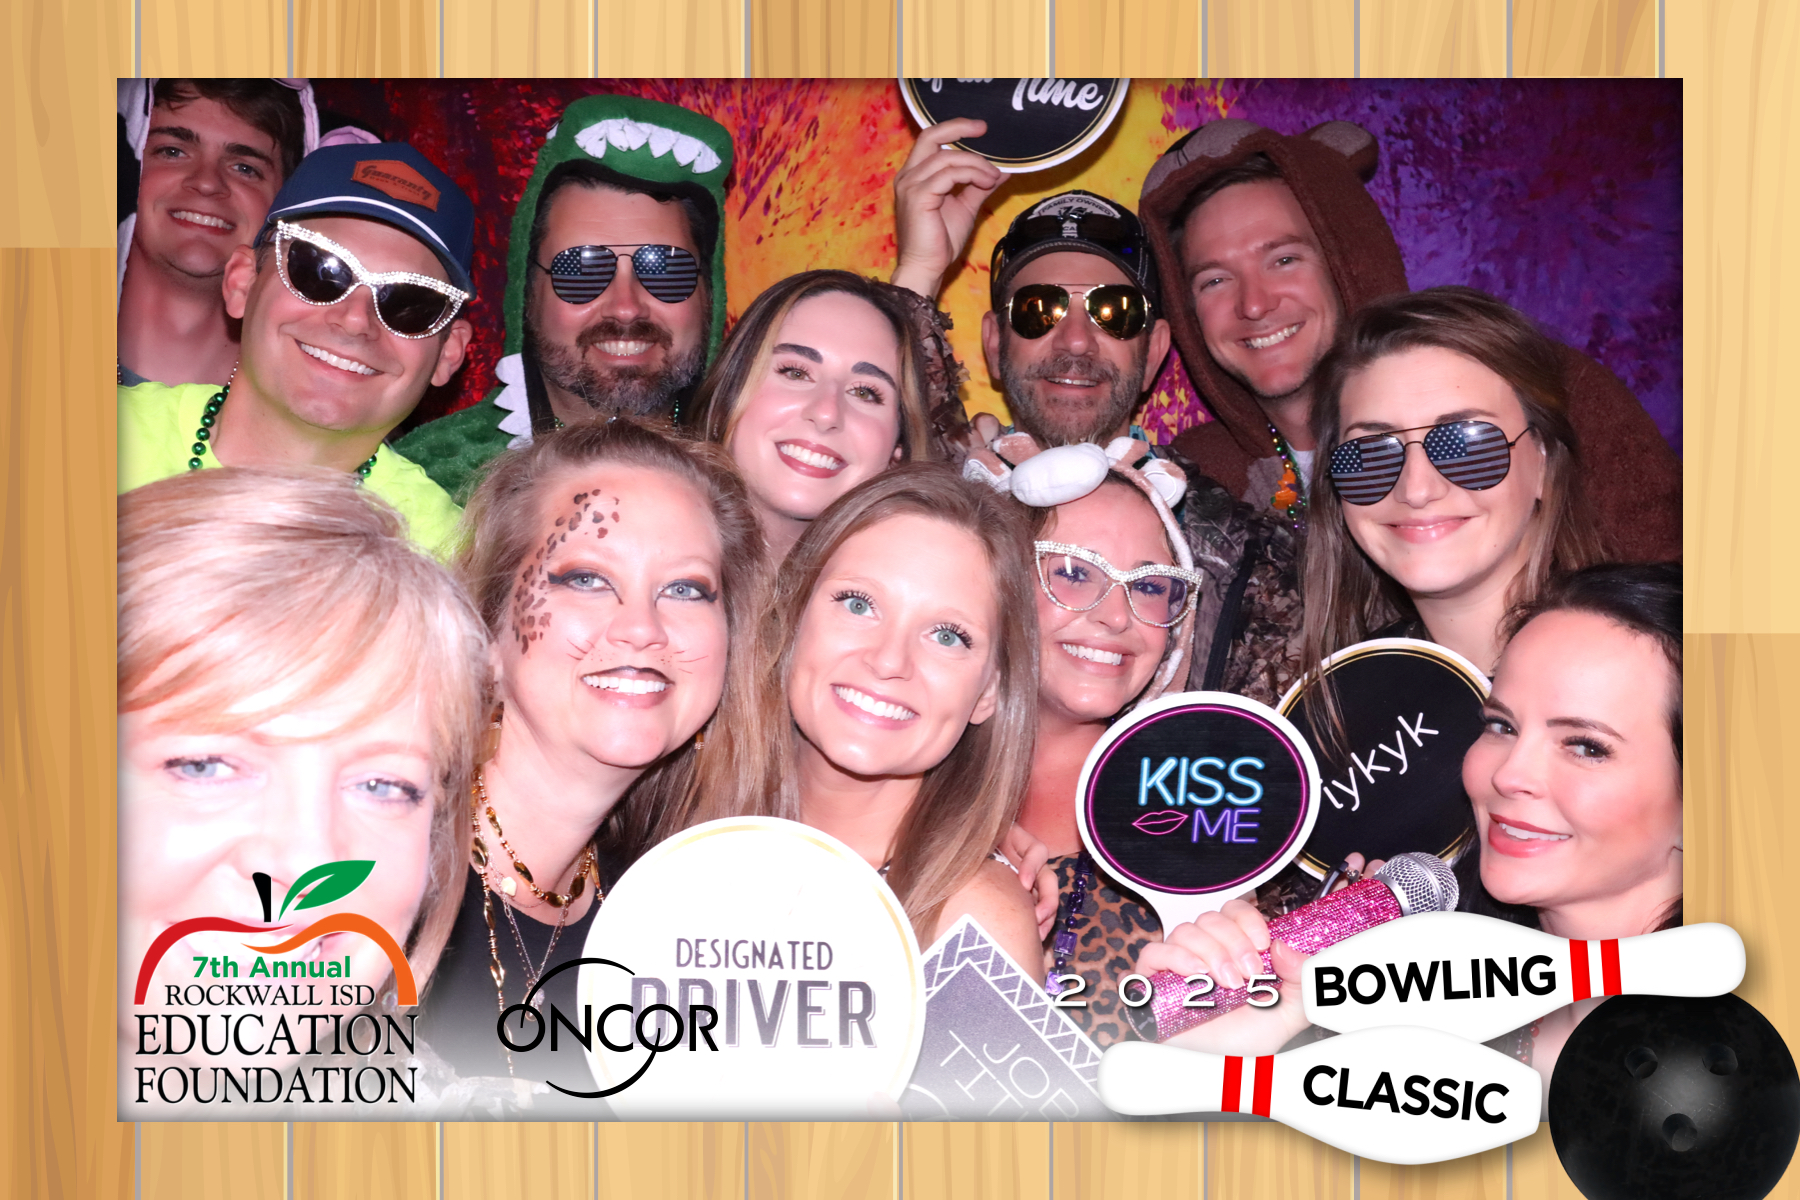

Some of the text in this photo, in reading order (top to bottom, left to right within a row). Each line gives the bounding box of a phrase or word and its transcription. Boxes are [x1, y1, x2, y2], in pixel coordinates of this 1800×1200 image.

[1011, 77, 1103, 111] Time
[361, 165, 433, 200] Guaranty
[1041, 198, 1074, 213] FAMILY
[1076, 198, 1112, 215] OWNED
[1320, 712, 1440, 812] iykyk
[1137, 756, 1265, 807] KISS
[1190, 807, 1262, 844] ME
[676, 938, 834, 971] DESIGNATED
[630, 977, 878, 1048] DRIVER
